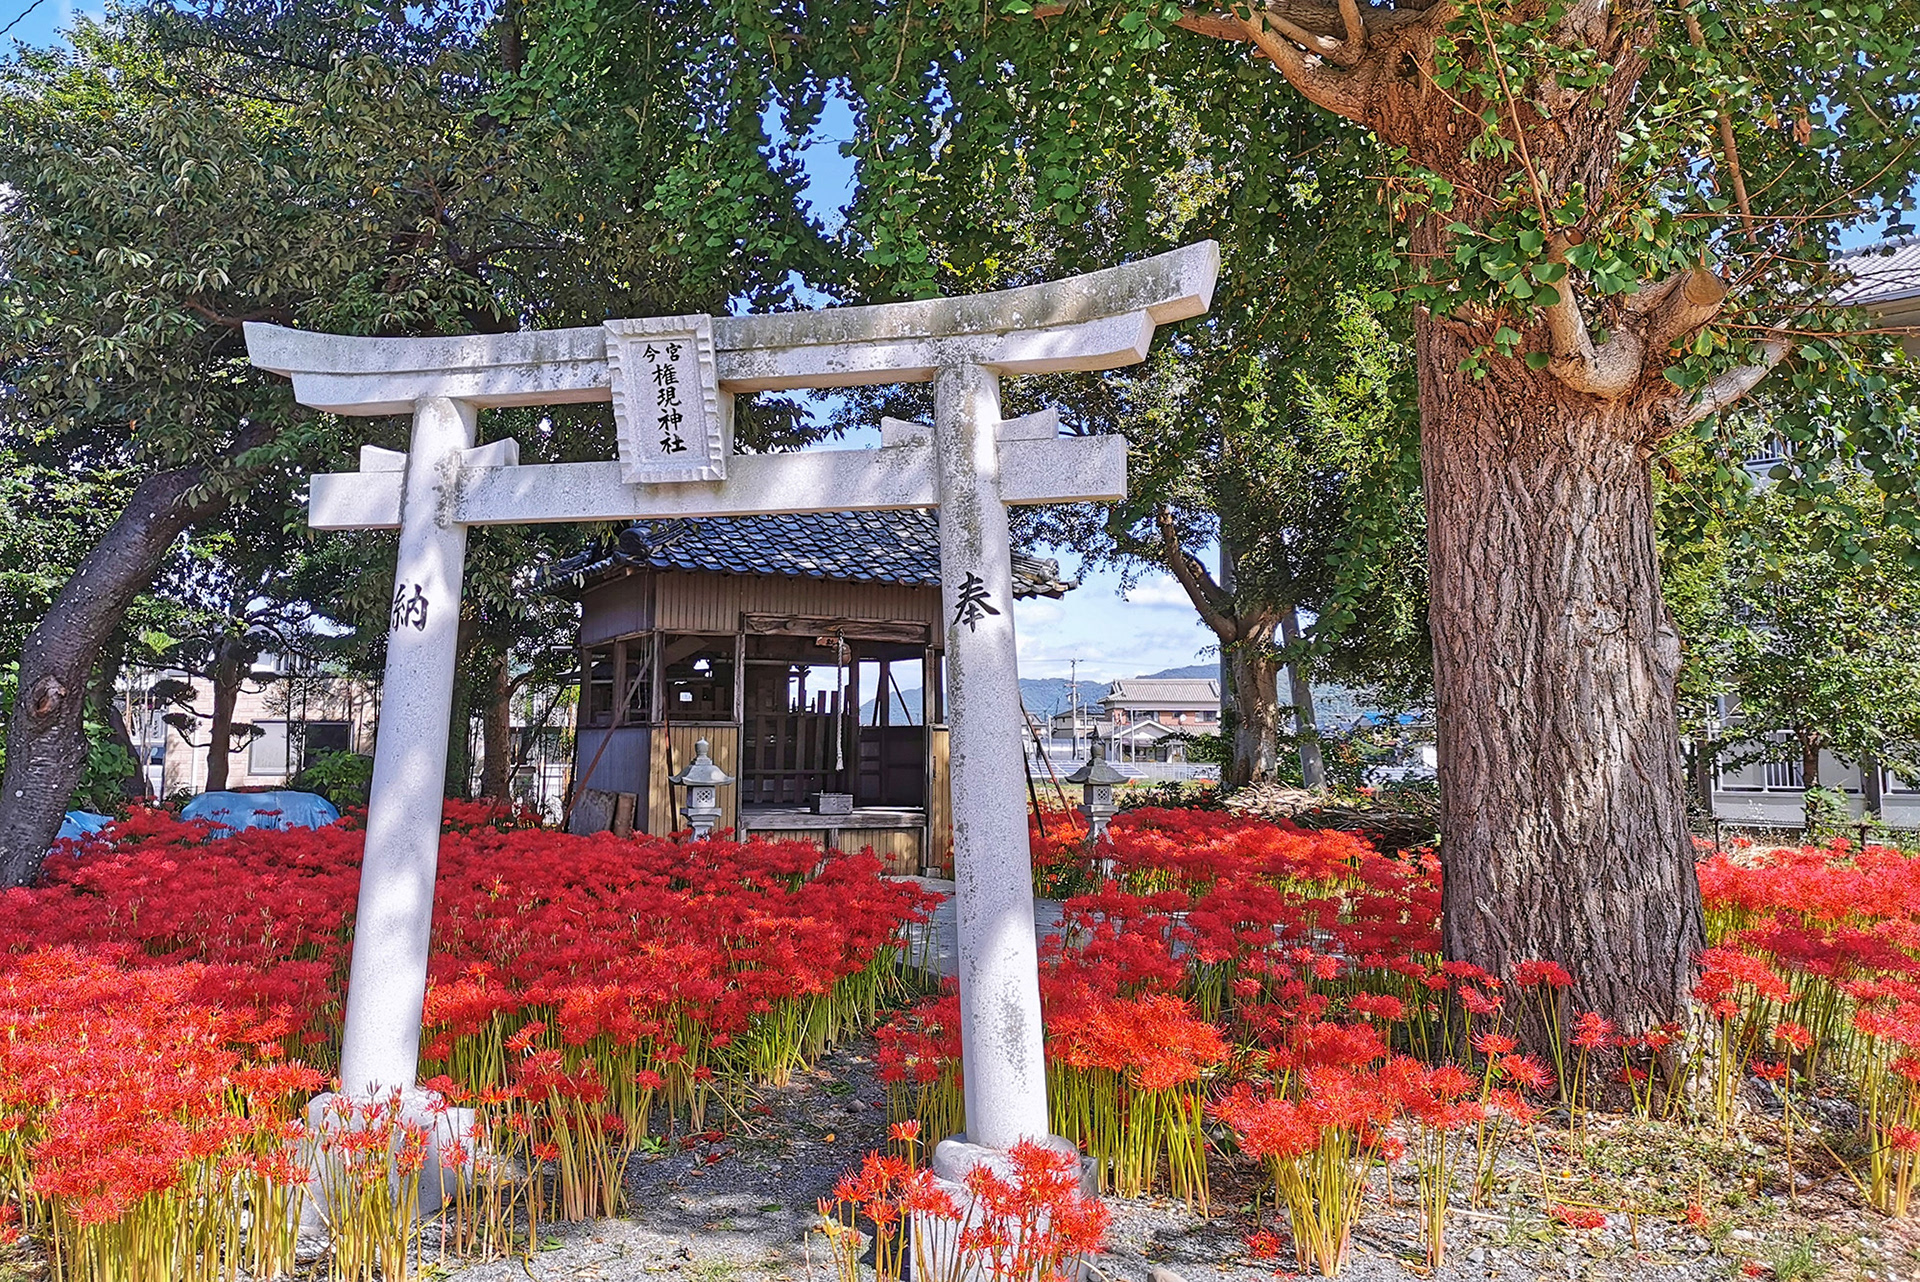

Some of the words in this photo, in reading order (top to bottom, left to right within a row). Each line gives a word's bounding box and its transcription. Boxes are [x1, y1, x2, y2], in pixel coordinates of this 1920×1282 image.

[643, 343, 682, 363] 今宮
[652, 363, 687, 454] 権現神社
[392, 583, 429, 631] 納
[953, 571, 1001, 633] 奉
